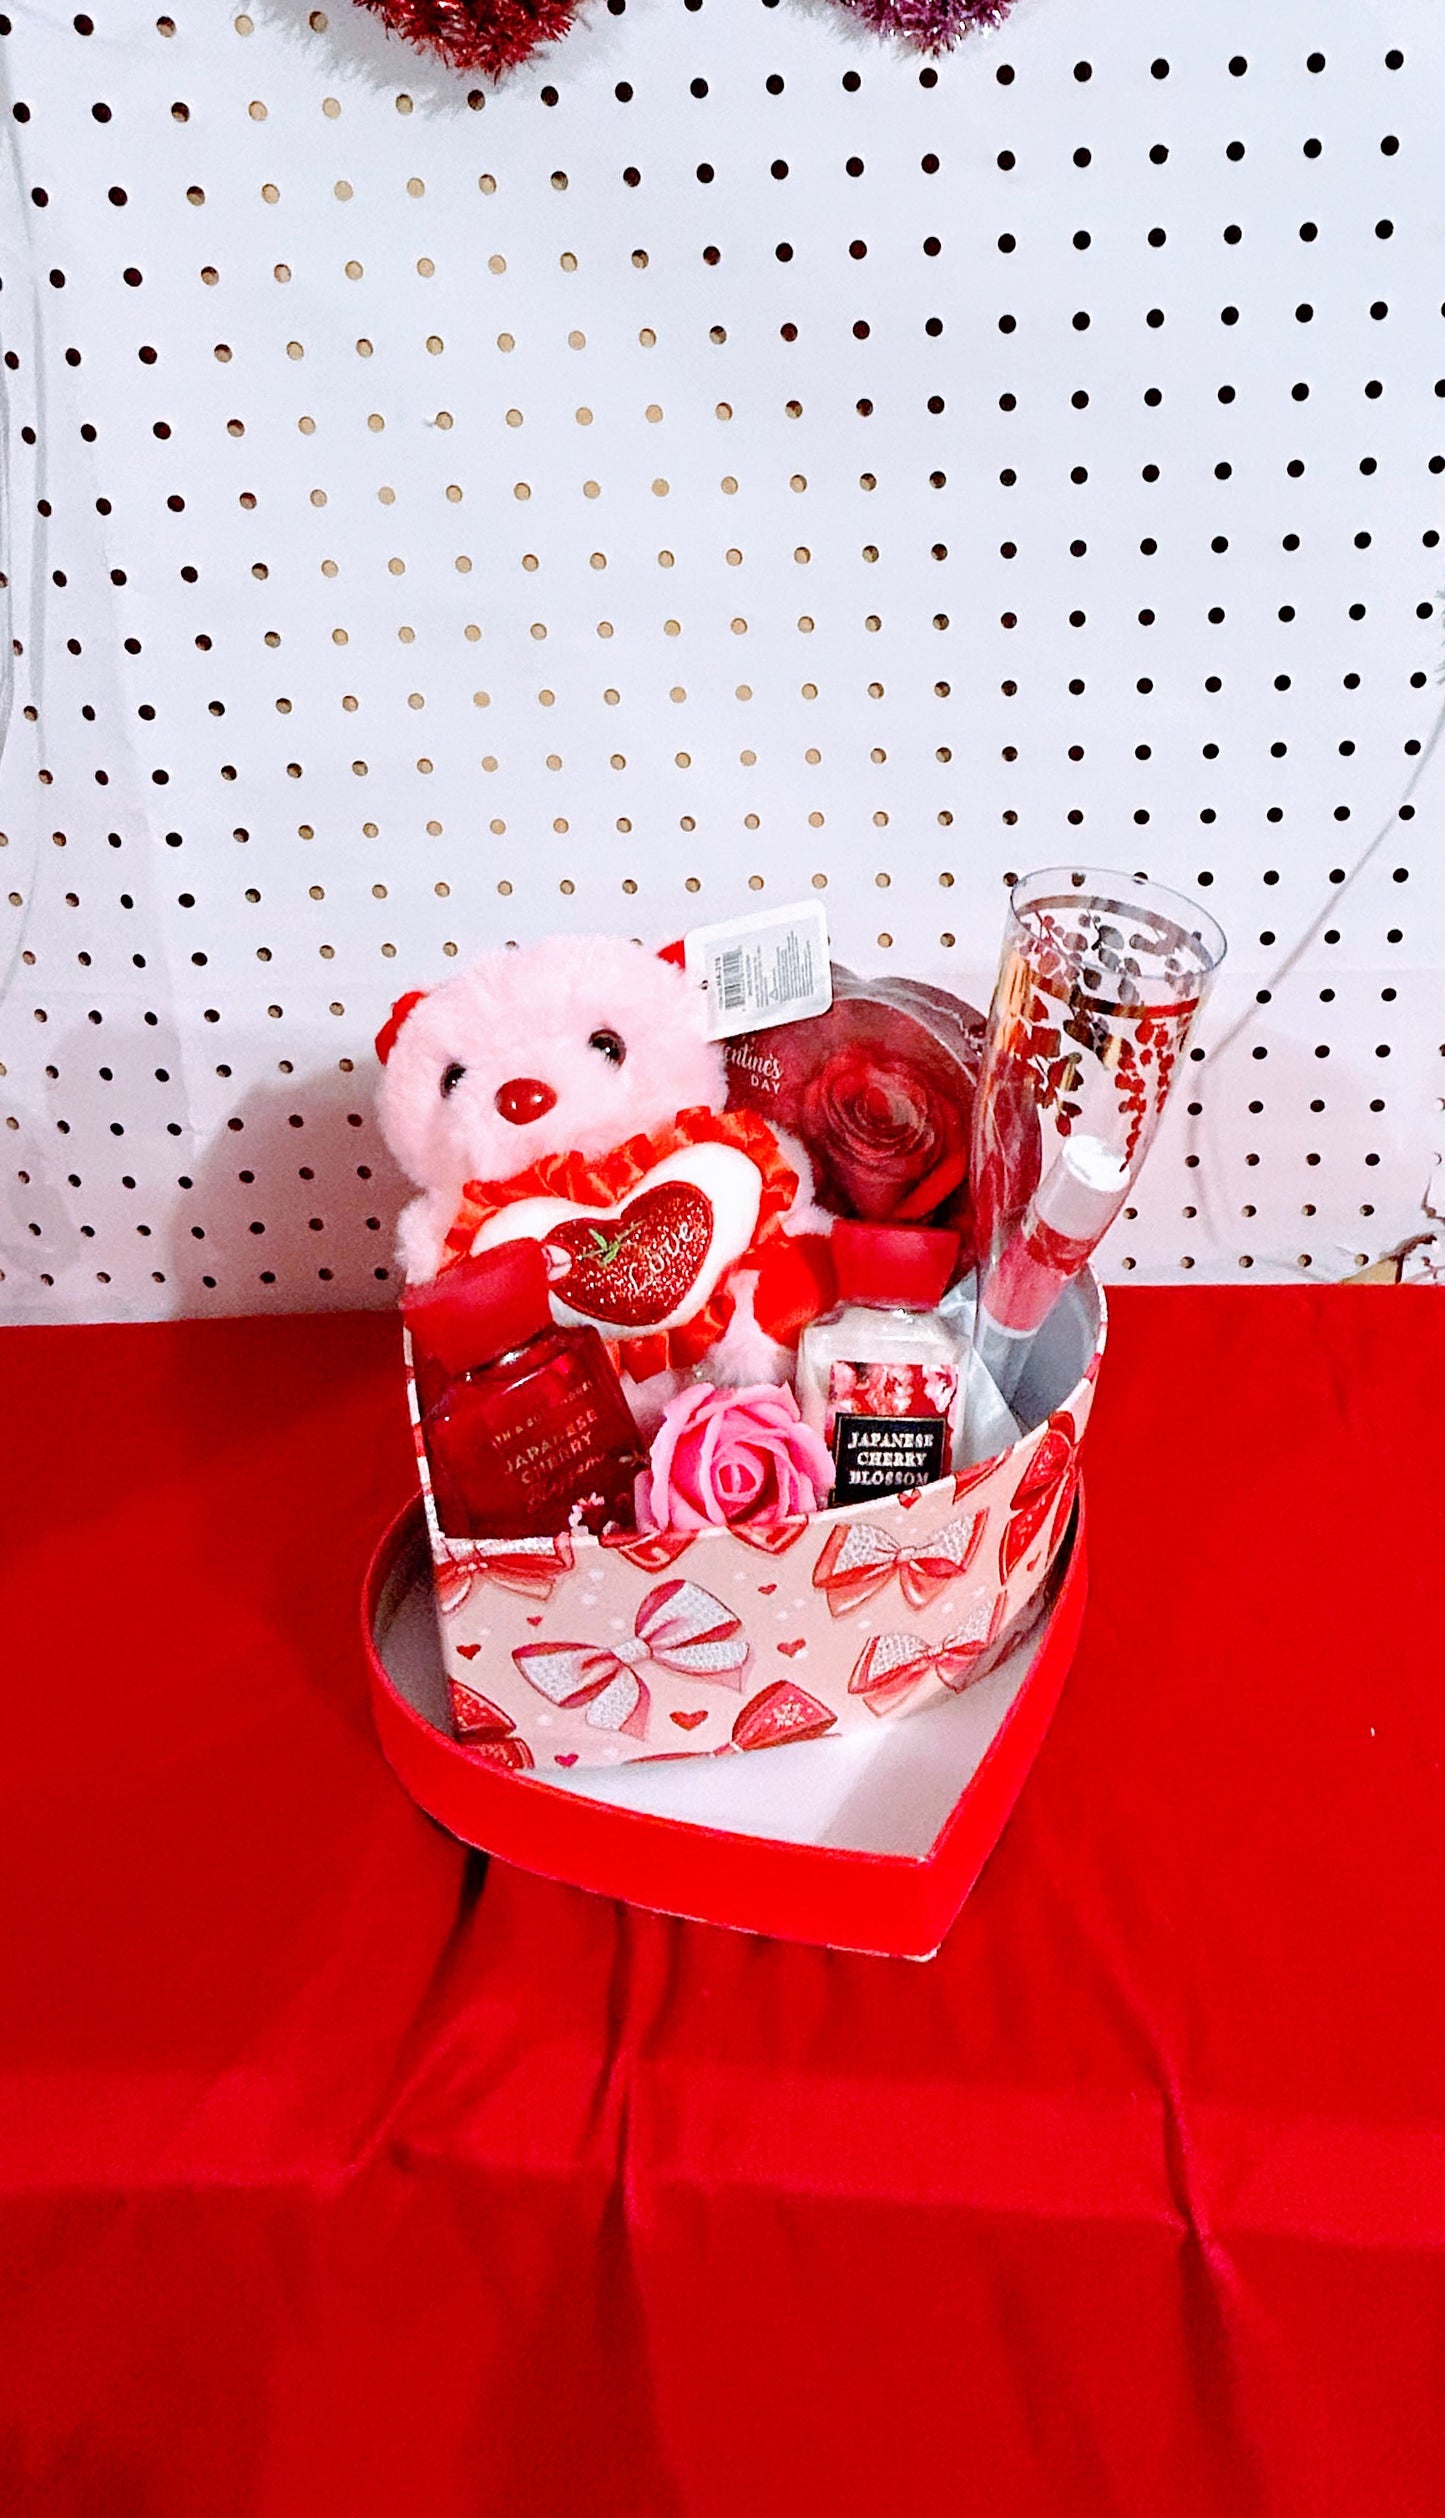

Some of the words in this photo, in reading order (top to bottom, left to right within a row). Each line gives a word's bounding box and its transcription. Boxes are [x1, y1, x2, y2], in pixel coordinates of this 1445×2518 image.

[724, 1045, 784, 1080] entine's
[750, 1073, 781, 1095] DAY
[628, 1221, 696, 1296] Love
[847, 1431, 935, 1449] JAPANESE
[857, 1451, 928, 1468] CHERRY
[848, 1470, 930, 1486] BLOSSOM
